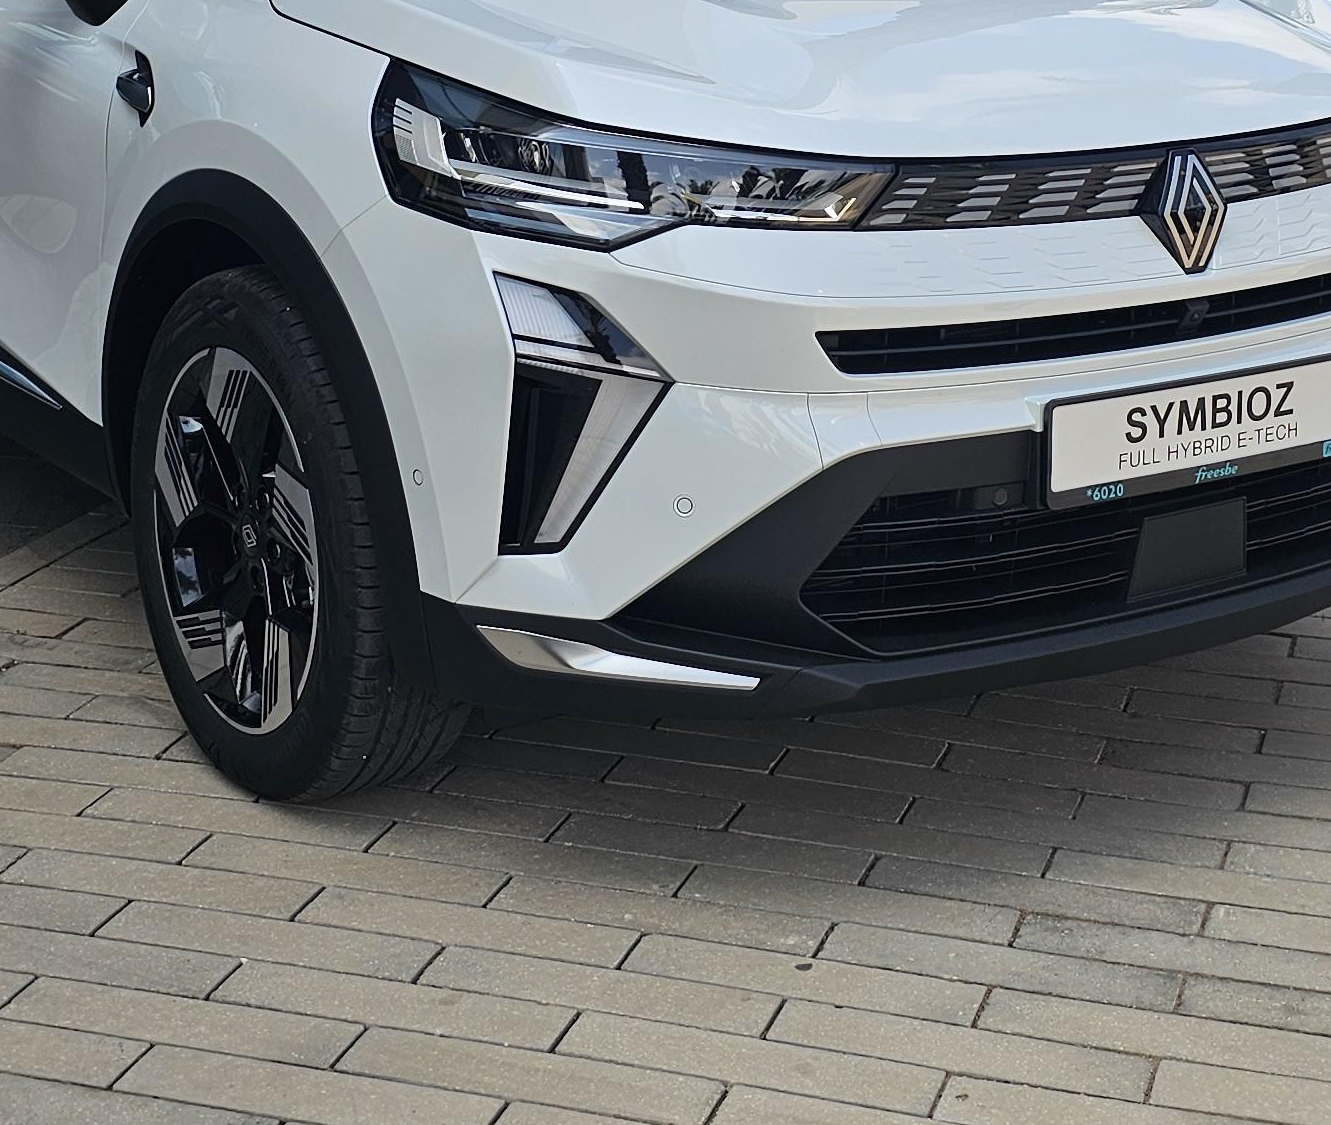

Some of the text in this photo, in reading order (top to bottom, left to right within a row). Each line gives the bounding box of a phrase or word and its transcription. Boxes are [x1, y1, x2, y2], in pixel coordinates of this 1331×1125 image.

[1124, 380, 1295, 444] SYMBIOZ
[1118, 421, 1299, 470] FULL HYBRID E-TECH
[1194, 462, 1239, 484] freesbe
